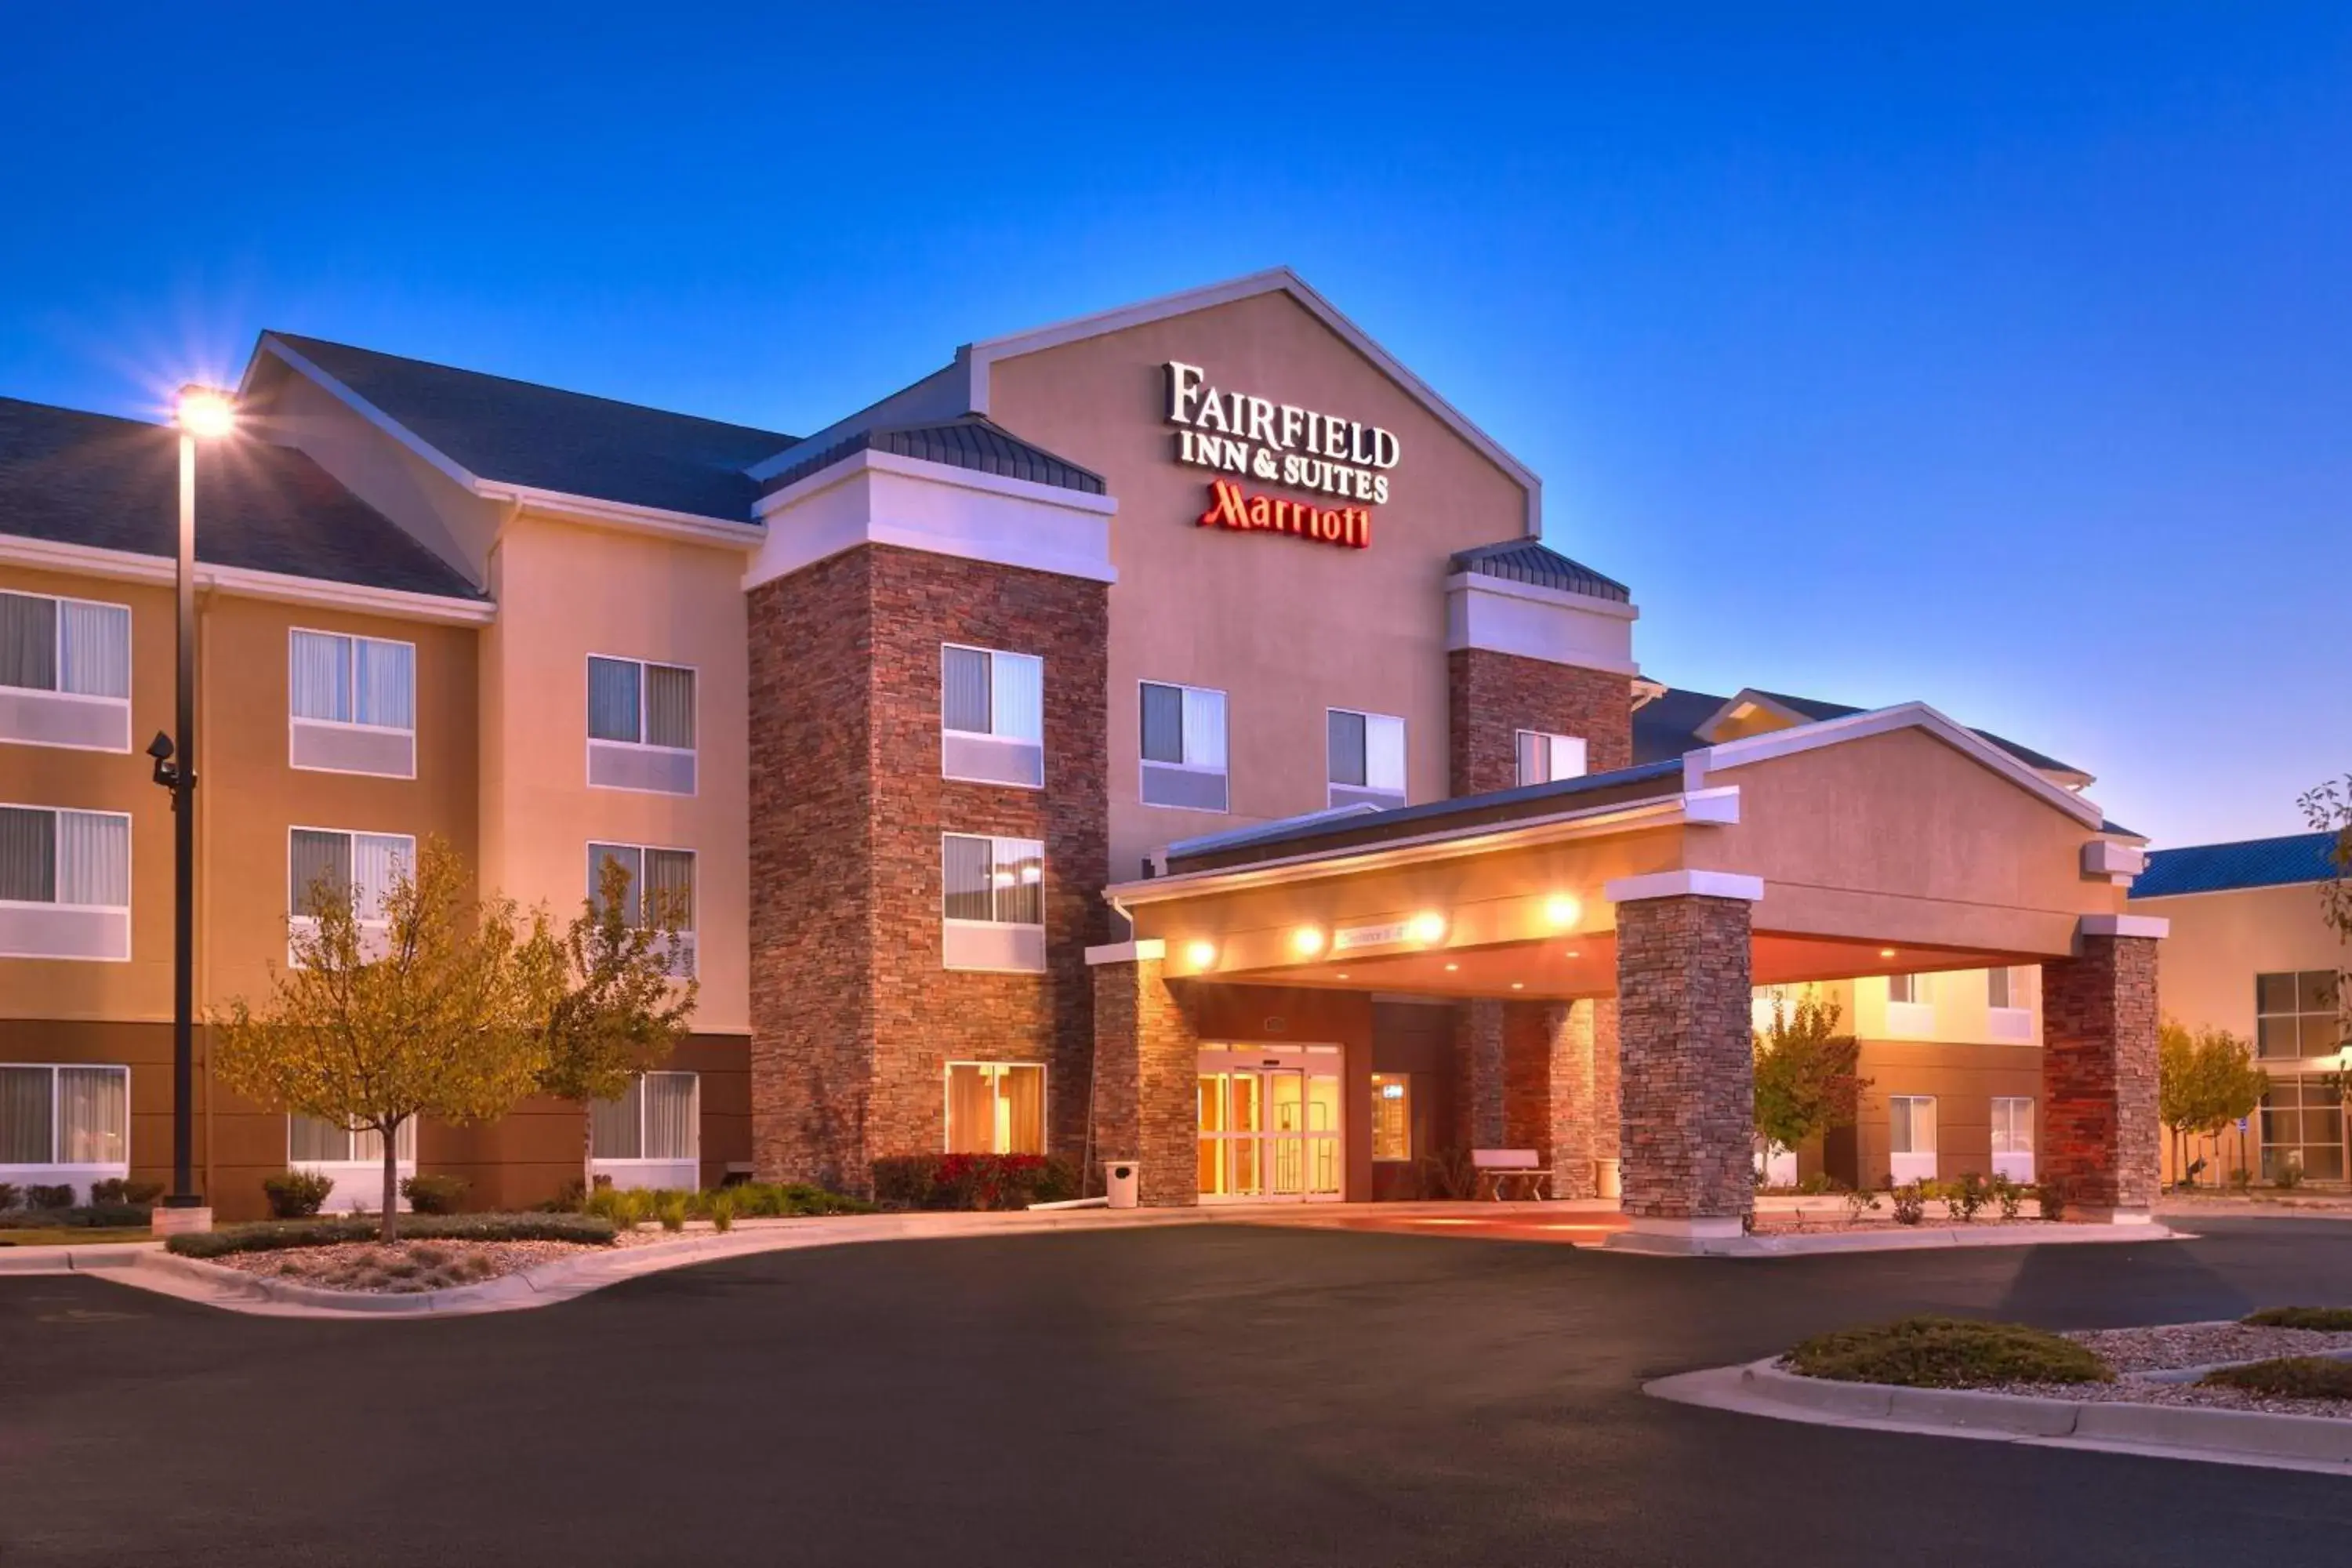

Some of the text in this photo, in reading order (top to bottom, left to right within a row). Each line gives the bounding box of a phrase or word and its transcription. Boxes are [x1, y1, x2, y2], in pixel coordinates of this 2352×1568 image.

[1167, 361, 1400, 469] FAIRFIELD
[1179, 430, 1389, 504] INN & SUITES
[1200, 479, 1370, 547] Marriott
